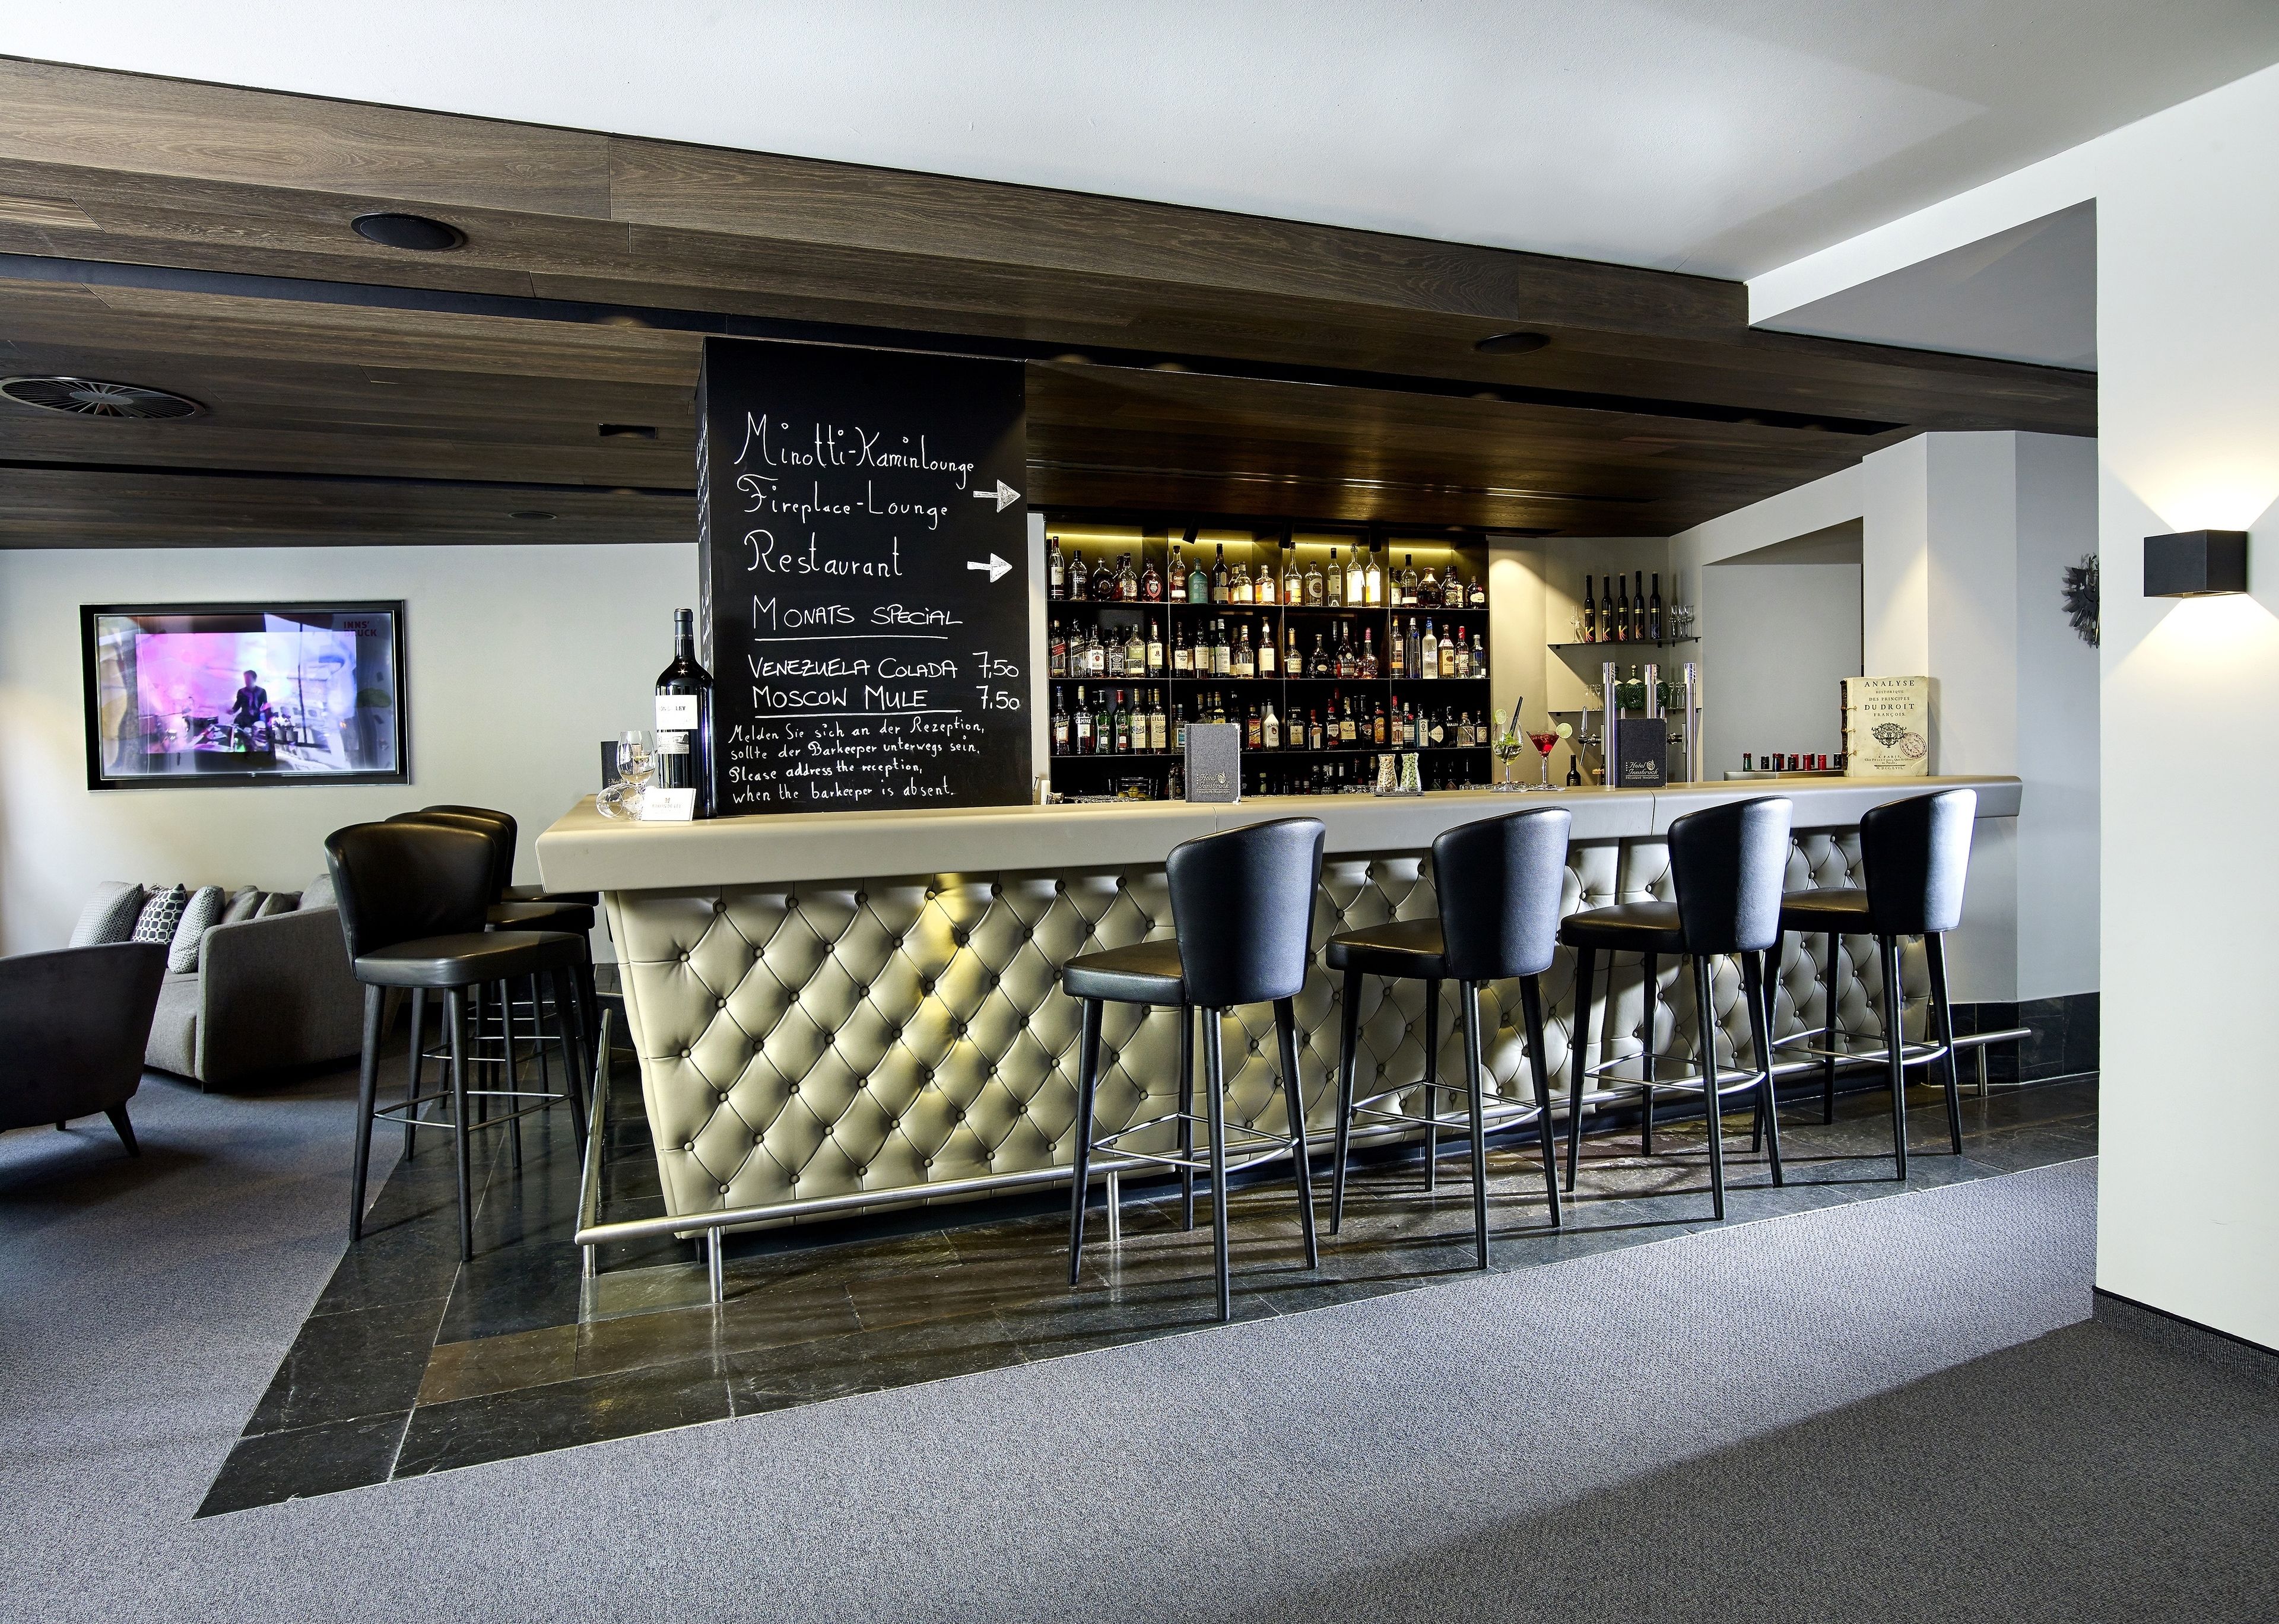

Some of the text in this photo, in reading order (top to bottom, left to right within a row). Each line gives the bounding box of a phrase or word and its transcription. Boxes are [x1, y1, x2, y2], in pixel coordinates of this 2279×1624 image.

[734, 411, 974, 491] Minotti-Kaminlounge
[737, 473, 948, 530] Fireplace-Lounge
[744, 529, 903, 577] Restaurant
[753, 595, 855, 631] MONATS
[748, 651, 1019, 679] VENEZUELA COLADA 7,50
[752, 685, 1021, 711] MOSCOW MULE 7,50
[728, 716, 985, 743] Melden Sie sich an der Rezeption,
[731, 745, 767, 760] sollte
[777, 743, 801, 758] der
[807, 739, 877, 759] Barkeeper
[883, 736, 942, 758] unterwegs
[729, 757, 922, 783] Please address the reception,
[732, 775, 954, 804] when the barkeeper is absent.
